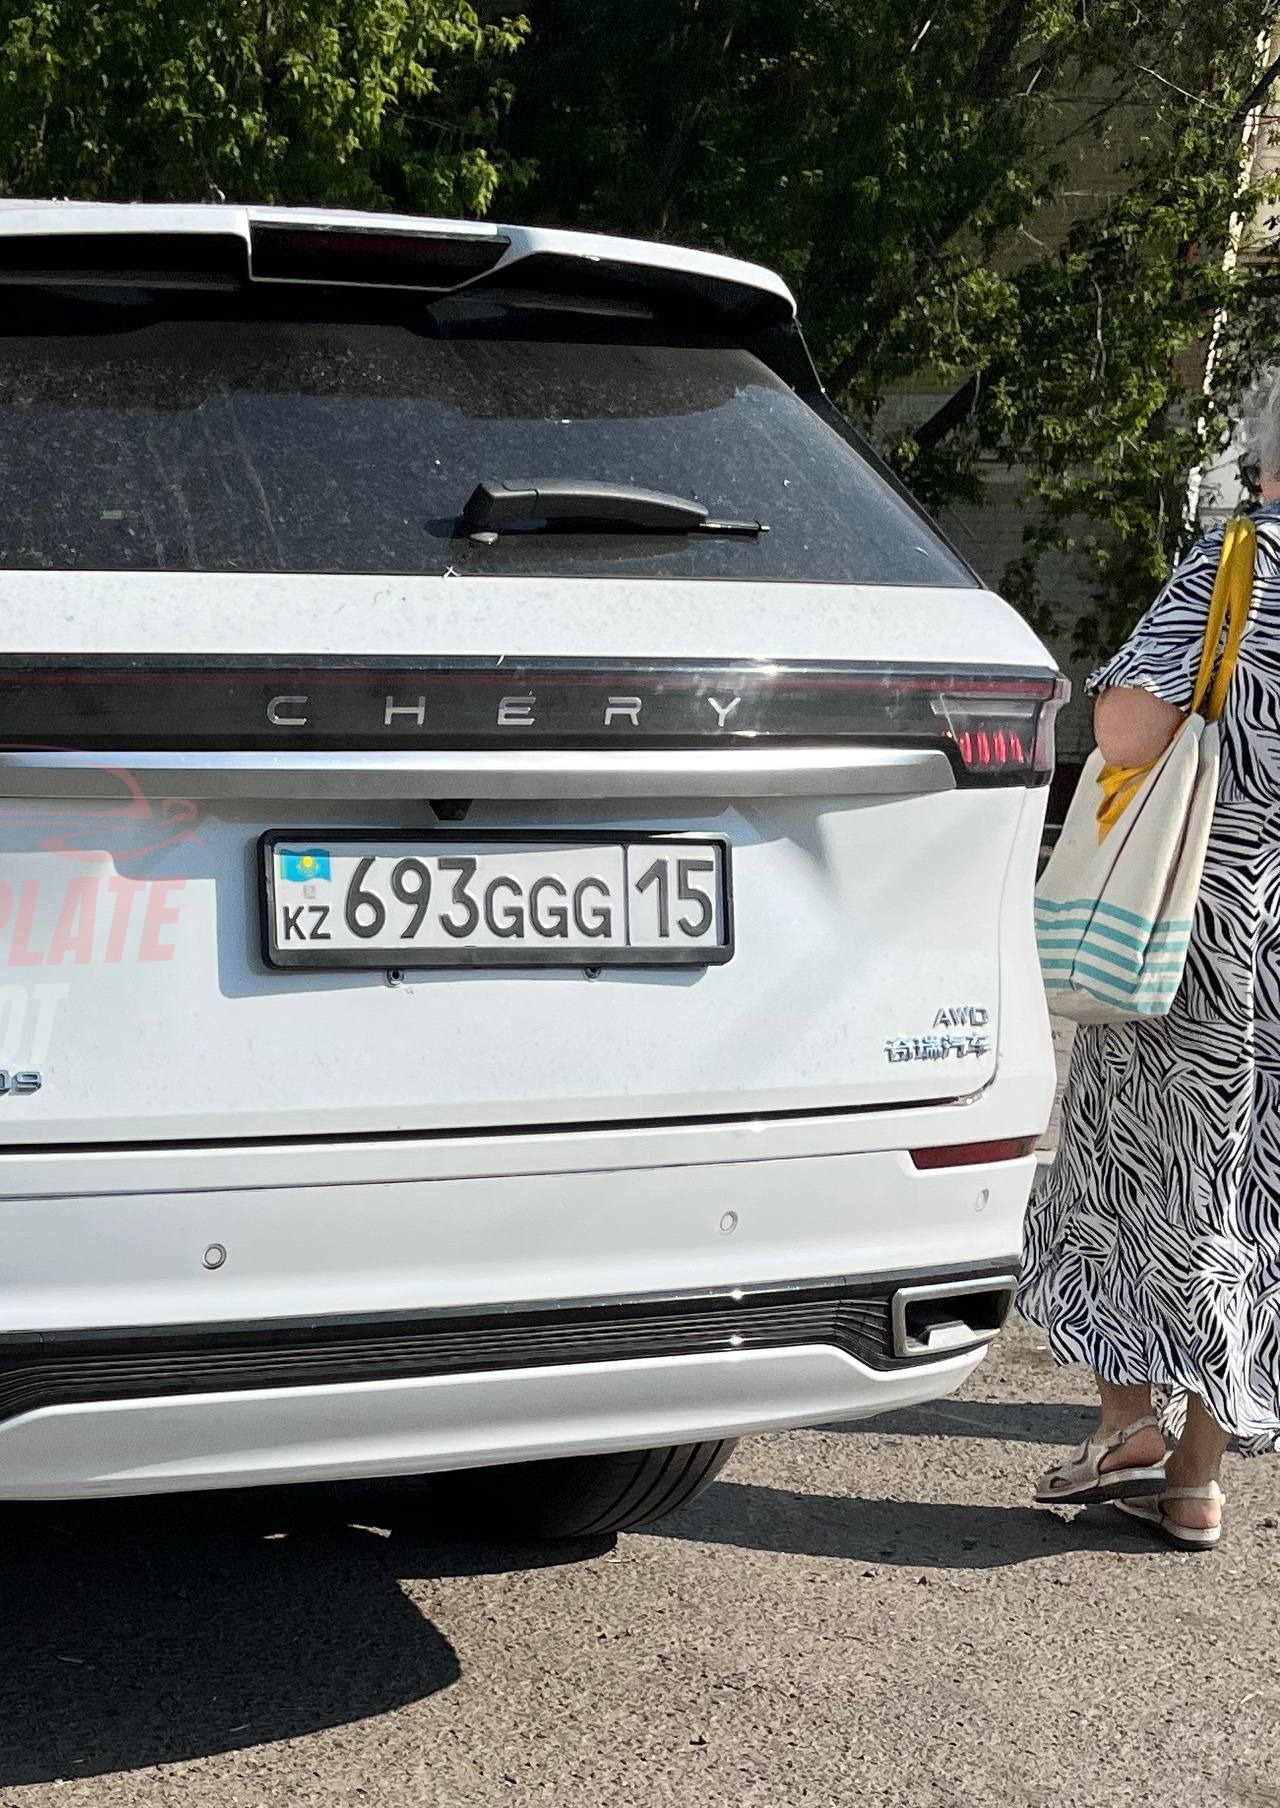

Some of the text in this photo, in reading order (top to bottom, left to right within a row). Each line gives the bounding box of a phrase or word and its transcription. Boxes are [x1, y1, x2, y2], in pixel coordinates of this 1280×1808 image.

[266, 695, 742, 727] CHERY
[283, 905, 332, 940] KZ
[634, 858, 715, 939] 15
[932, 1006, 989, 1029] AWD
[883, 1033, 991, 1063] 奇瑞汽车
